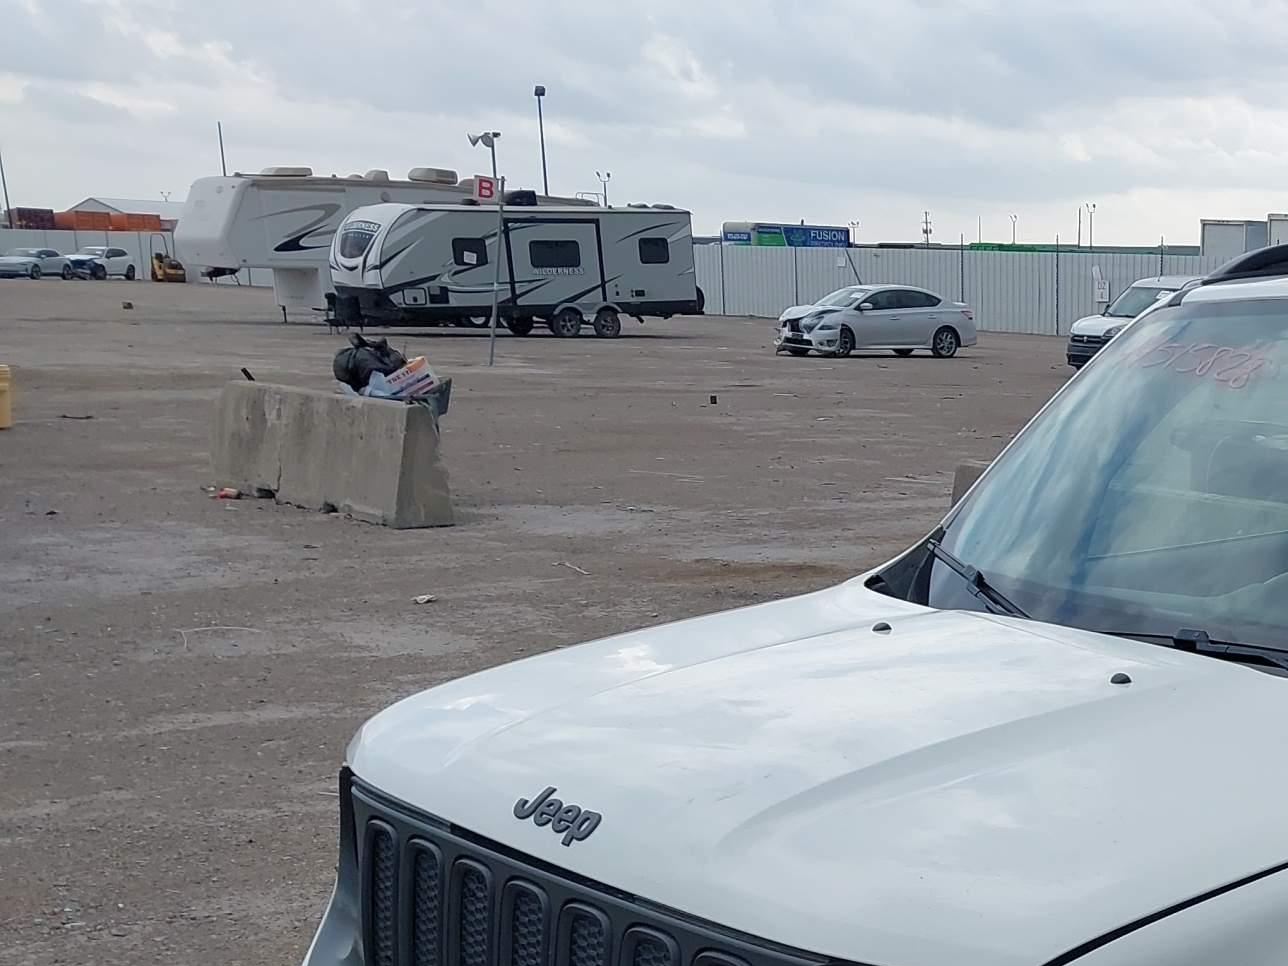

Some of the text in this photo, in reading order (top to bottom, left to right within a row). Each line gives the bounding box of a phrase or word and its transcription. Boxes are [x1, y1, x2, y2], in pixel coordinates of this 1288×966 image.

[478, 179, 494, 199] B
[810, 230, 846, 241] FUSION
[532, 267, 584, 276] WILDERNESS
[513, 786, 602, 847] Jeep
